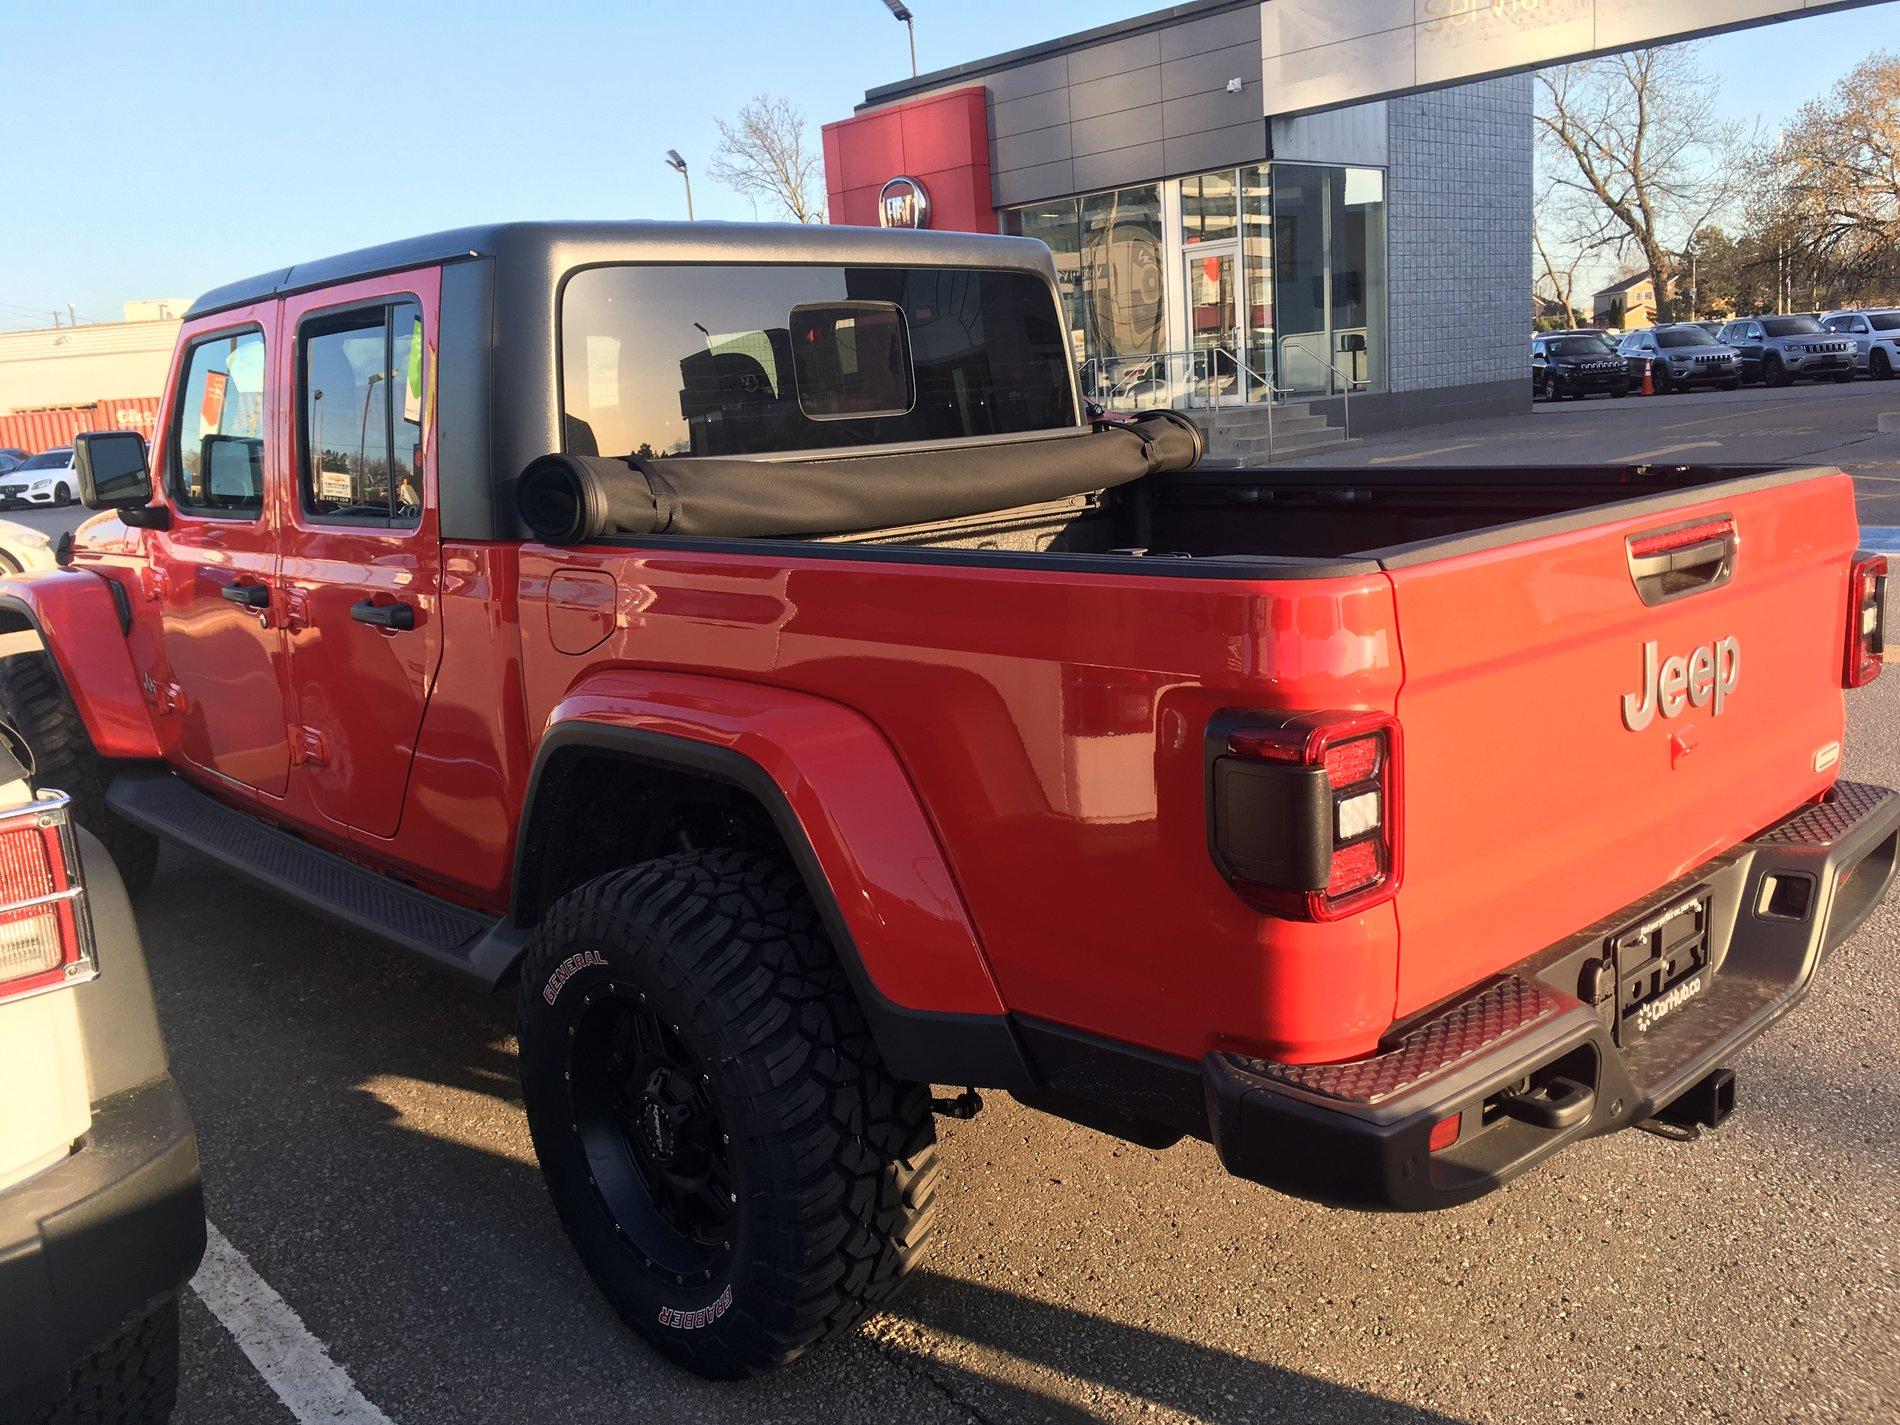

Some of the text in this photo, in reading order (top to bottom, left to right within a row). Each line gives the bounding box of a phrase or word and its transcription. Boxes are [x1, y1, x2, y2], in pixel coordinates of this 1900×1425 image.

[886, 194, 914, 227] FIAT
[1620, 634, 1740, 733] Jeep
[543, 950, 608, 1006] GENERAL
[659, 1283, 733, 1330] GRABBER
